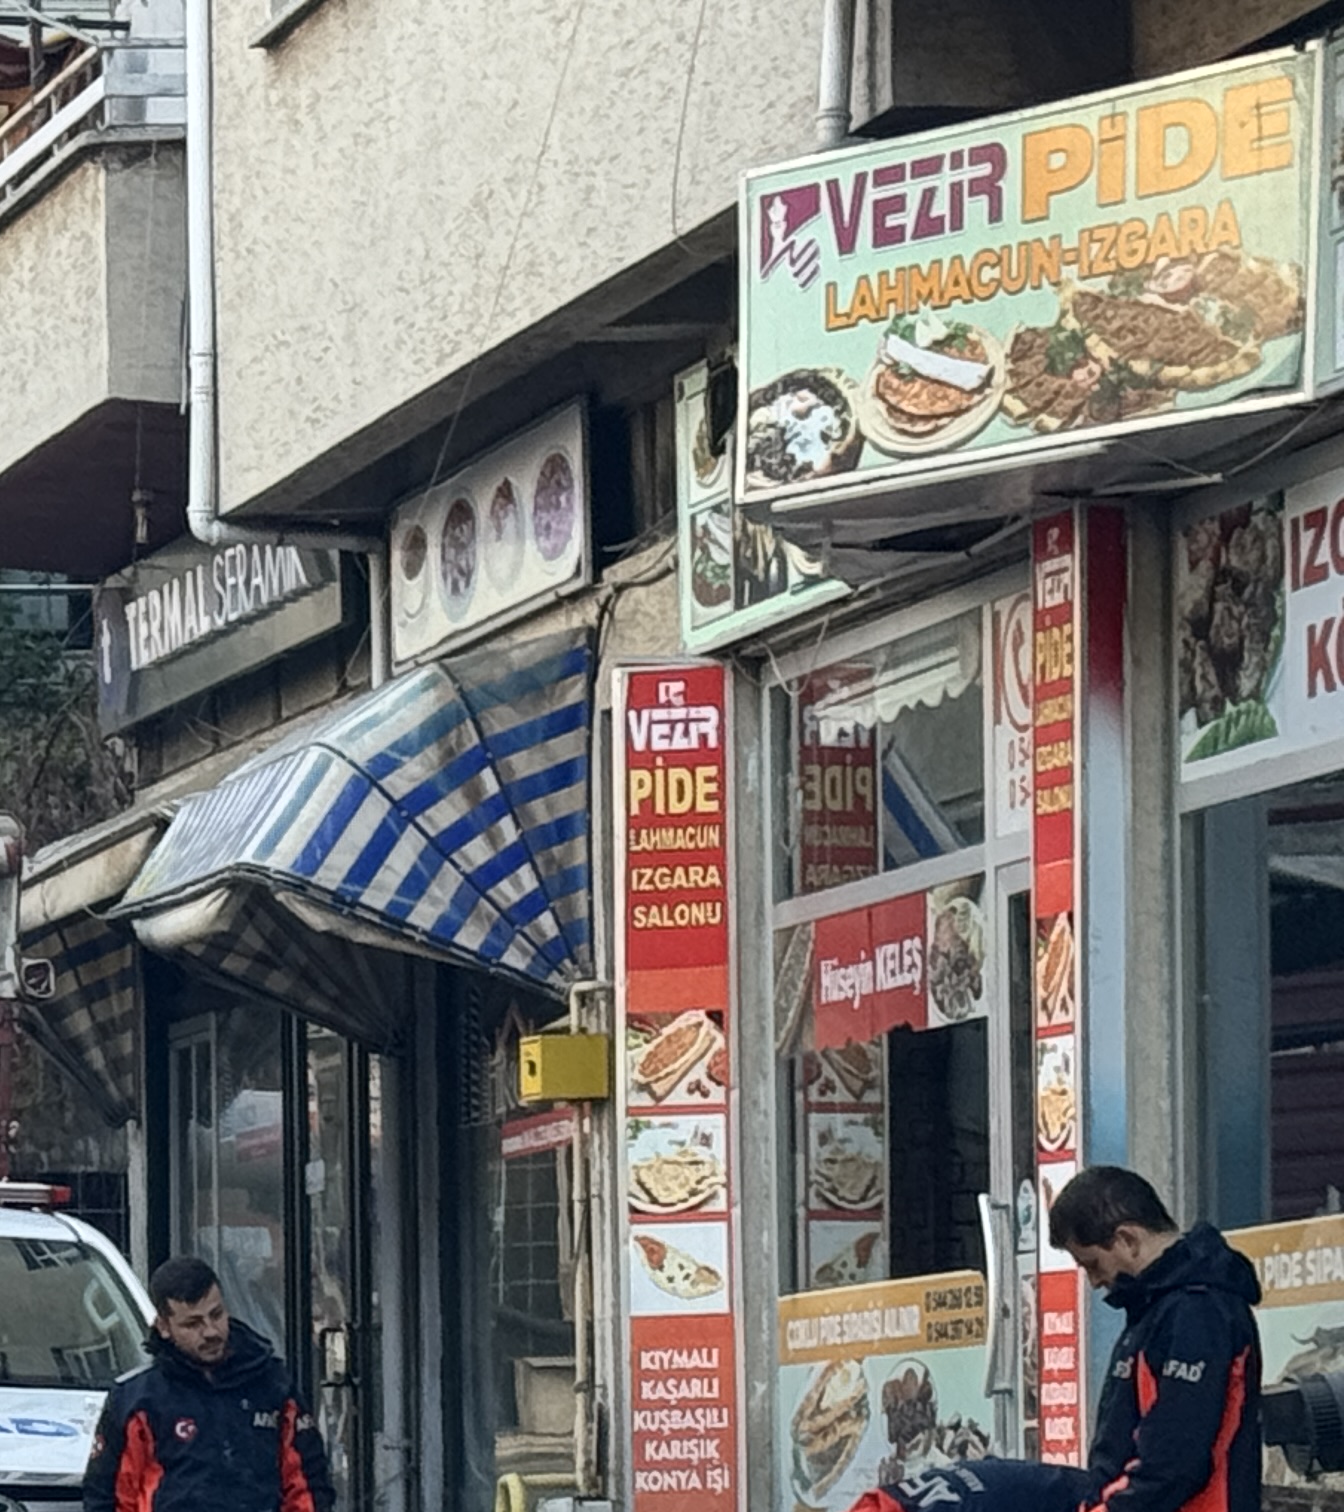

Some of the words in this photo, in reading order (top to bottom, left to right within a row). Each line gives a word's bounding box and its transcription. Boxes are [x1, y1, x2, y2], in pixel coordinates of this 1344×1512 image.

[125, 563, 212, 671] TERMAL
[629, 756, 721, 817] PİDE
[629, 825, 720, 851] LAHMACUN
[631, 865, 721, 891] IZGARA
[633, 902, 722, 928] SALONU
[820, 949, 874, 1010] Hüseyin
[875, 936, 923, 996] KELEŞ
[640, 1348, 720, 1370] KIYMALI
[641, 1378, 720, 1405] KAŞARLI
[633, 1407, 729, 1436] KUŞBAŞILI
[644, 1438, 721, 1465] KARIŞIK
[635, 1469, 703, 1492] KONYA
[706, 1463, 730, 1495] İŞİ
